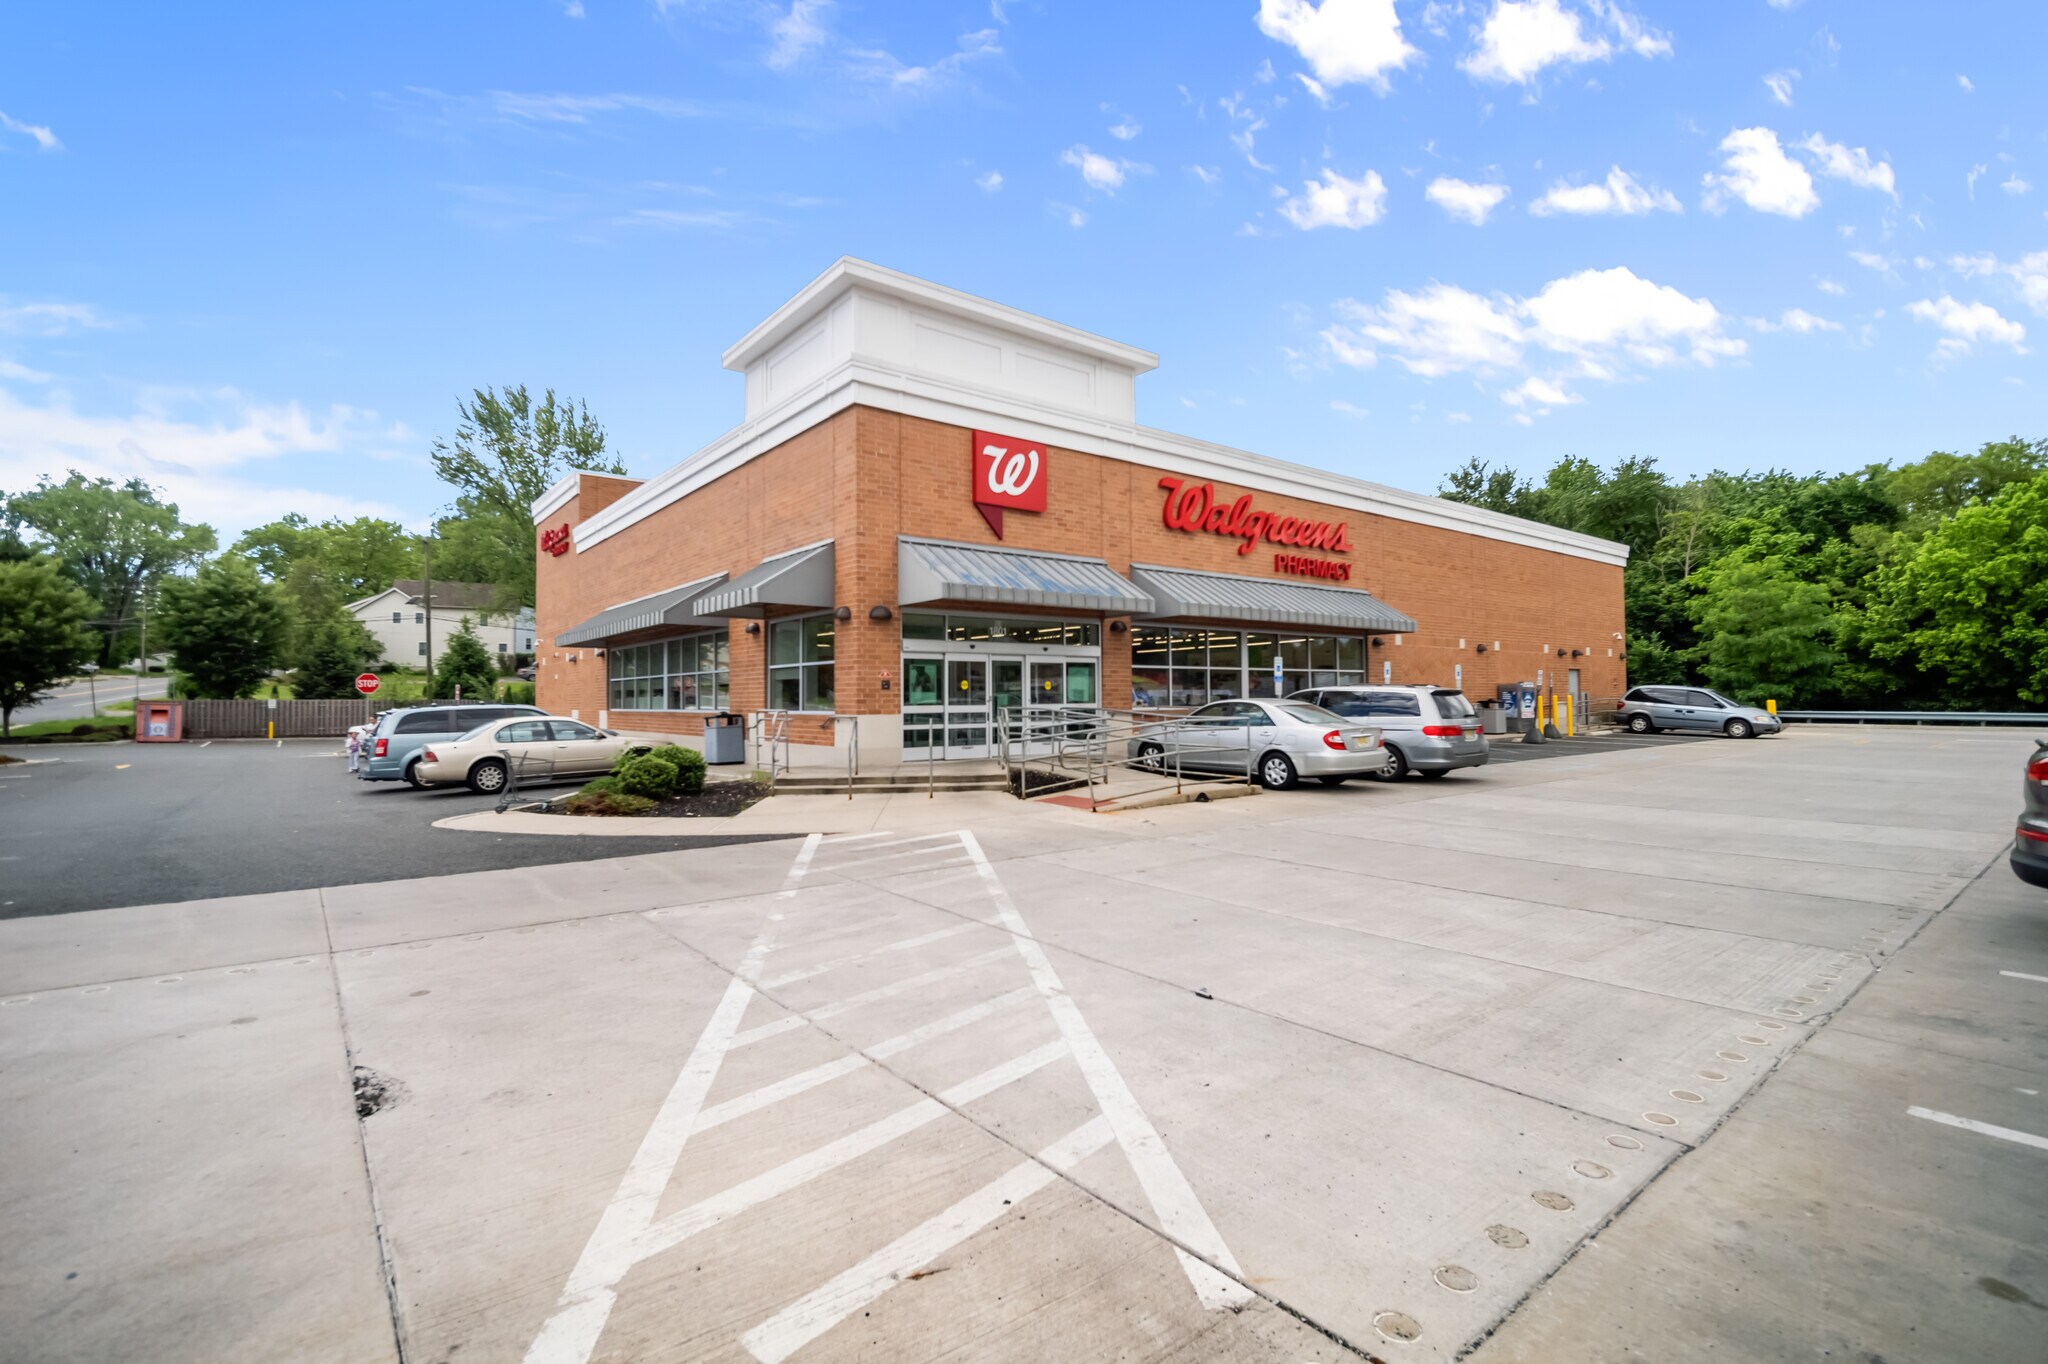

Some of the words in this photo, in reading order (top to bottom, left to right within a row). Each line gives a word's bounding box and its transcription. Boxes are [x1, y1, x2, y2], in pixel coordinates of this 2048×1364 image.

[1158, 476, 1353, 556] Walgreens
[1274, 554, 1352, 580] PHARMACY
[357, 679, 379, 688] STOP
